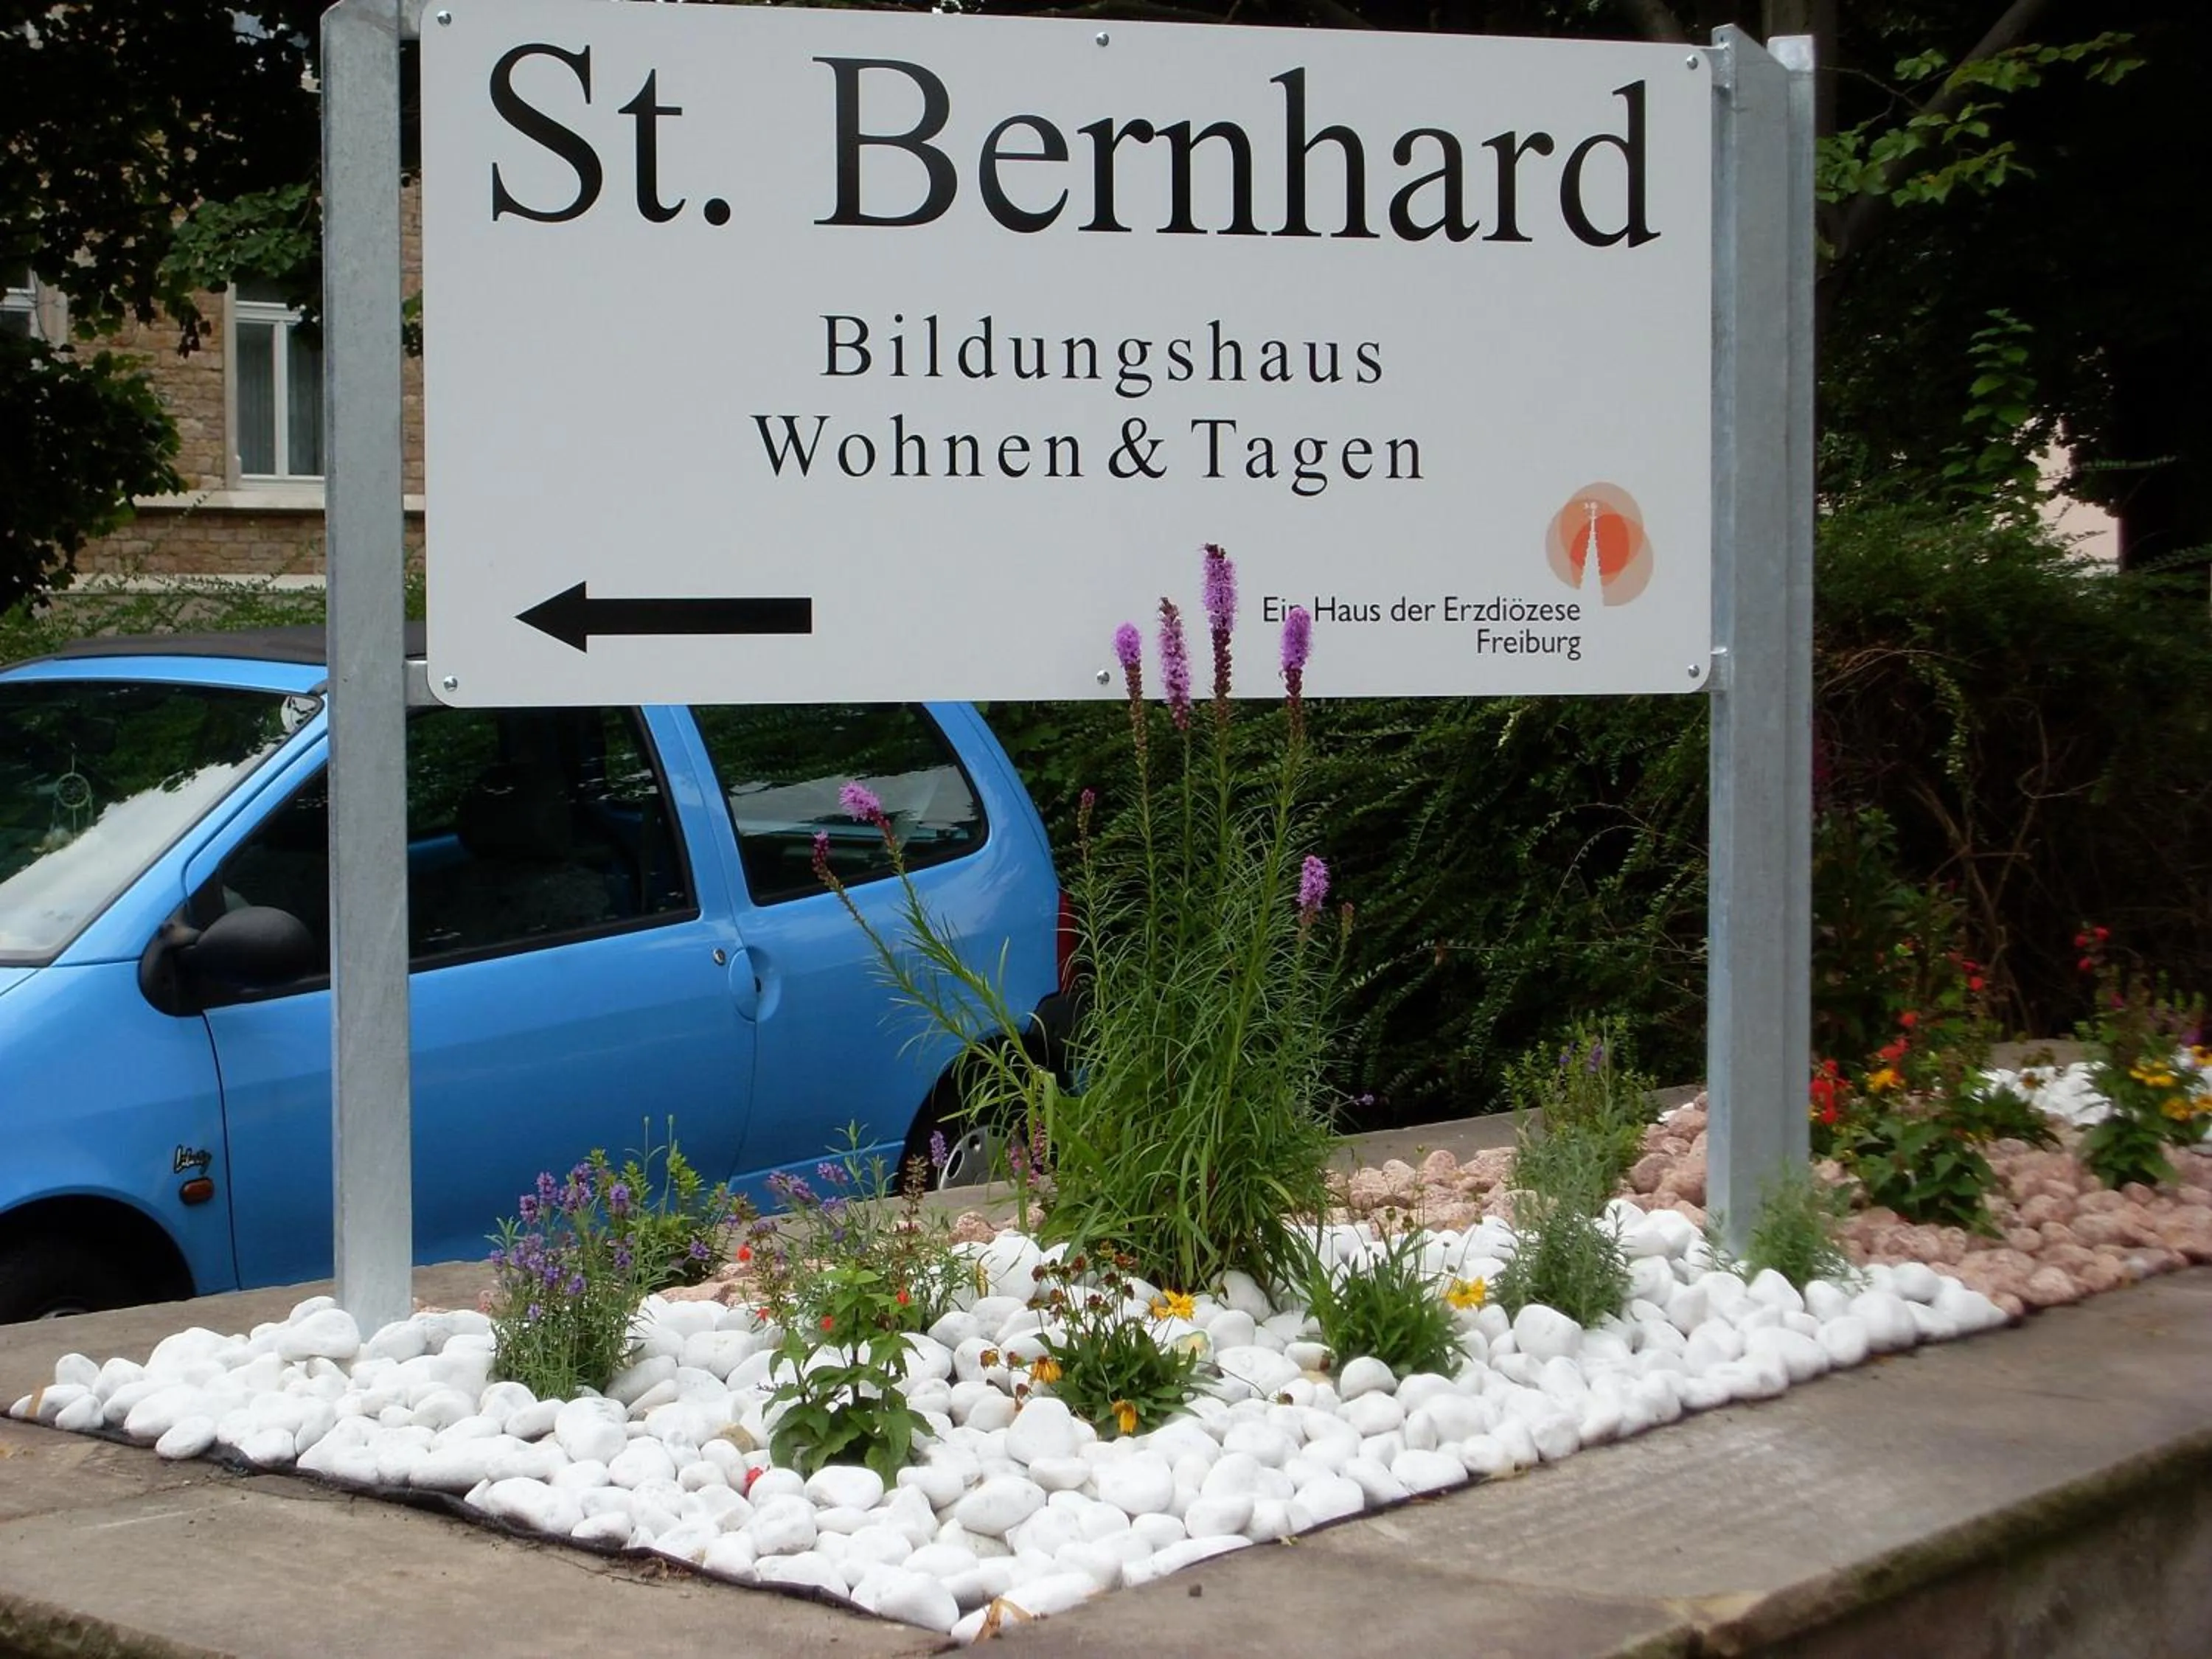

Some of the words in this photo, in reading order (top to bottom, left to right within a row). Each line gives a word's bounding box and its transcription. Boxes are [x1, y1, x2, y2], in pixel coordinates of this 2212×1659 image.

[488, 42, 731, 227] St.
[811, 55, 1662, 249] Bernhard
[818, 313, 1382, 400] Bildungshaus
[750, 414, 1085, 479] Wohnen
[1107, 416, 1168, 479] &
[1190, 419, 1424, 498] Tagen
[1262, 596, 1304, 622] Ei
[1314, 596, 1381, 623] Haus
[1390, 596, 1436, 623] der
[1444, 596, 1582, 622] Erzdiözese
[1476, 627, 1582, 661] Freiburg
